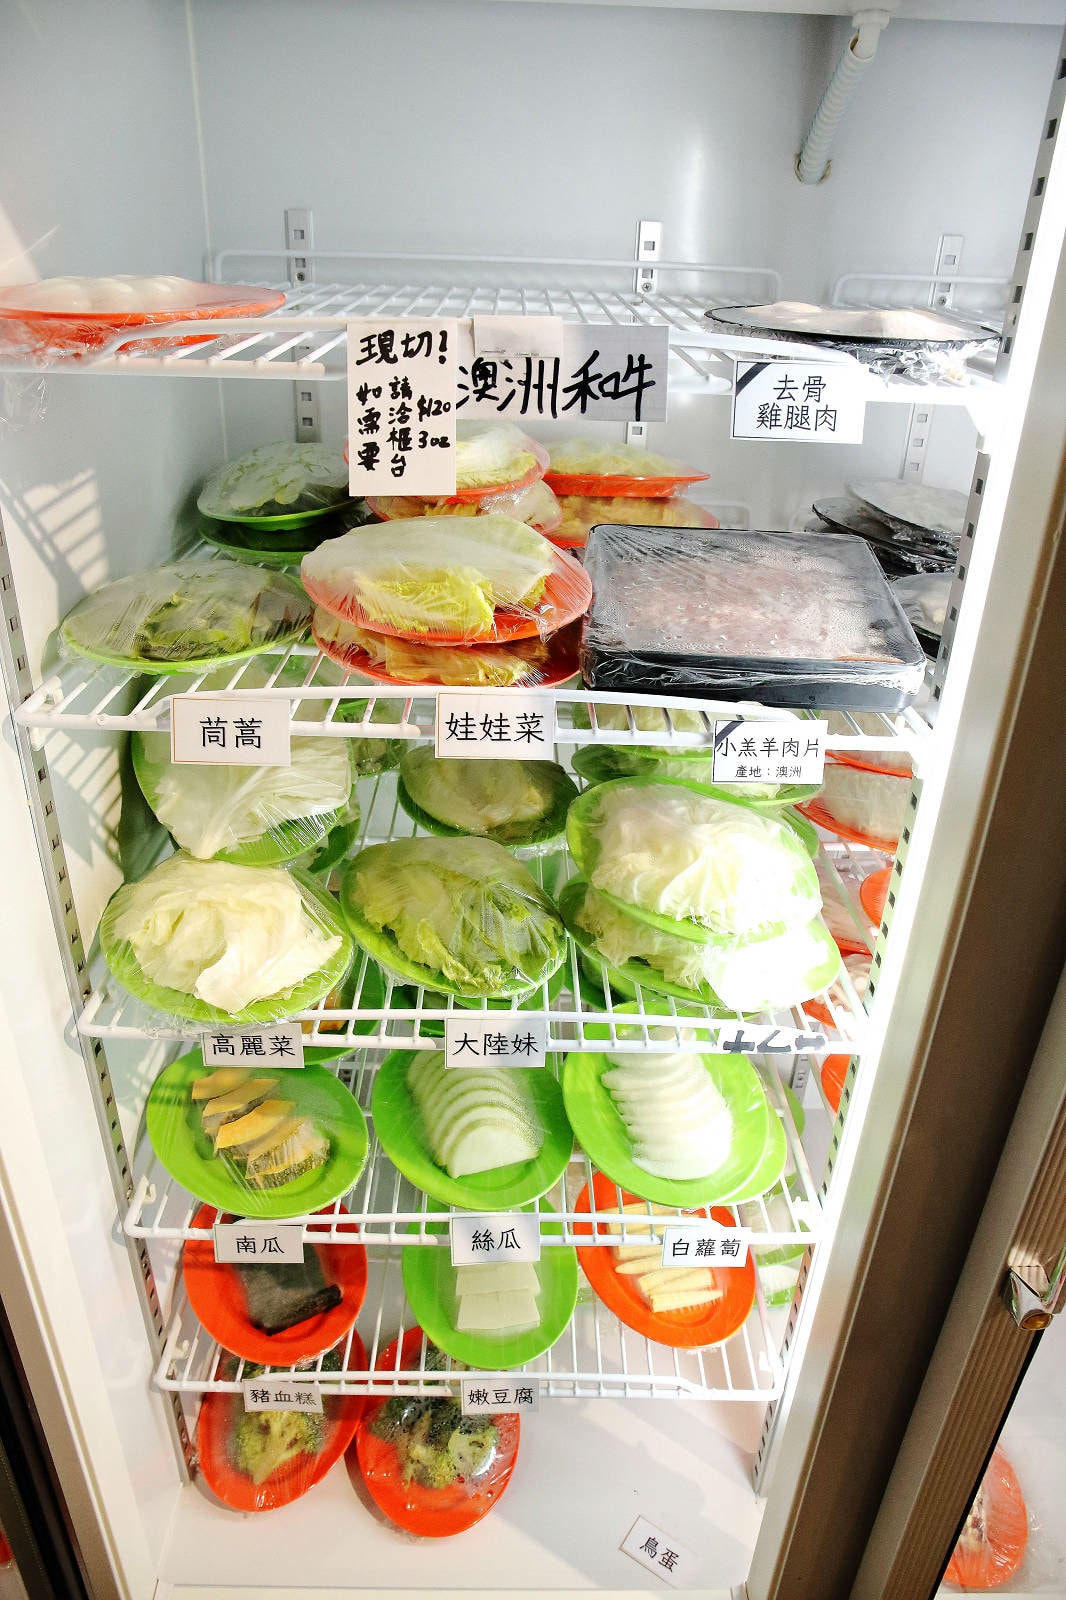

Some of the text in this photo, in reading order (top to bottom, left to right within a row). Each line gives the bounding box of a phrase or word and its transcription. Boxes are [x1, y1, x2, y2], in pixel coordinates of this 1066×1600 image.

[456, 350, 656, 421] 澳洲和牛
[773, 374, 826, 402] 去骨
[416, 395, 451, 422] $120
[756, 402, 837, 432] 雞腿肉
[355, 382, 383, 471] 如需要
[386, 376, 413, 477] 請洽櫃台
[200, 716, 262, 748] 茼蒿
[445, 712, 544, 743] 娃娃菜
[716, 737, 819, 758] 小羔羊肉片
[210, 1033, 296, 1056] 高麗菜
[453, 1032, 539, 1056] 大陸妹
[236, 1236, 285, 1254] 南瓜
[471, 1228, 521, 1251] 絲瓜
[672, 1238, 741, 1257] 白蘿蔔
[250, 1388, 317, 1406] 豬血糕
[467, 1387, 533, 1405] 嫩豆腐
[640, 1537, 680, 1573] 鳥蛋
